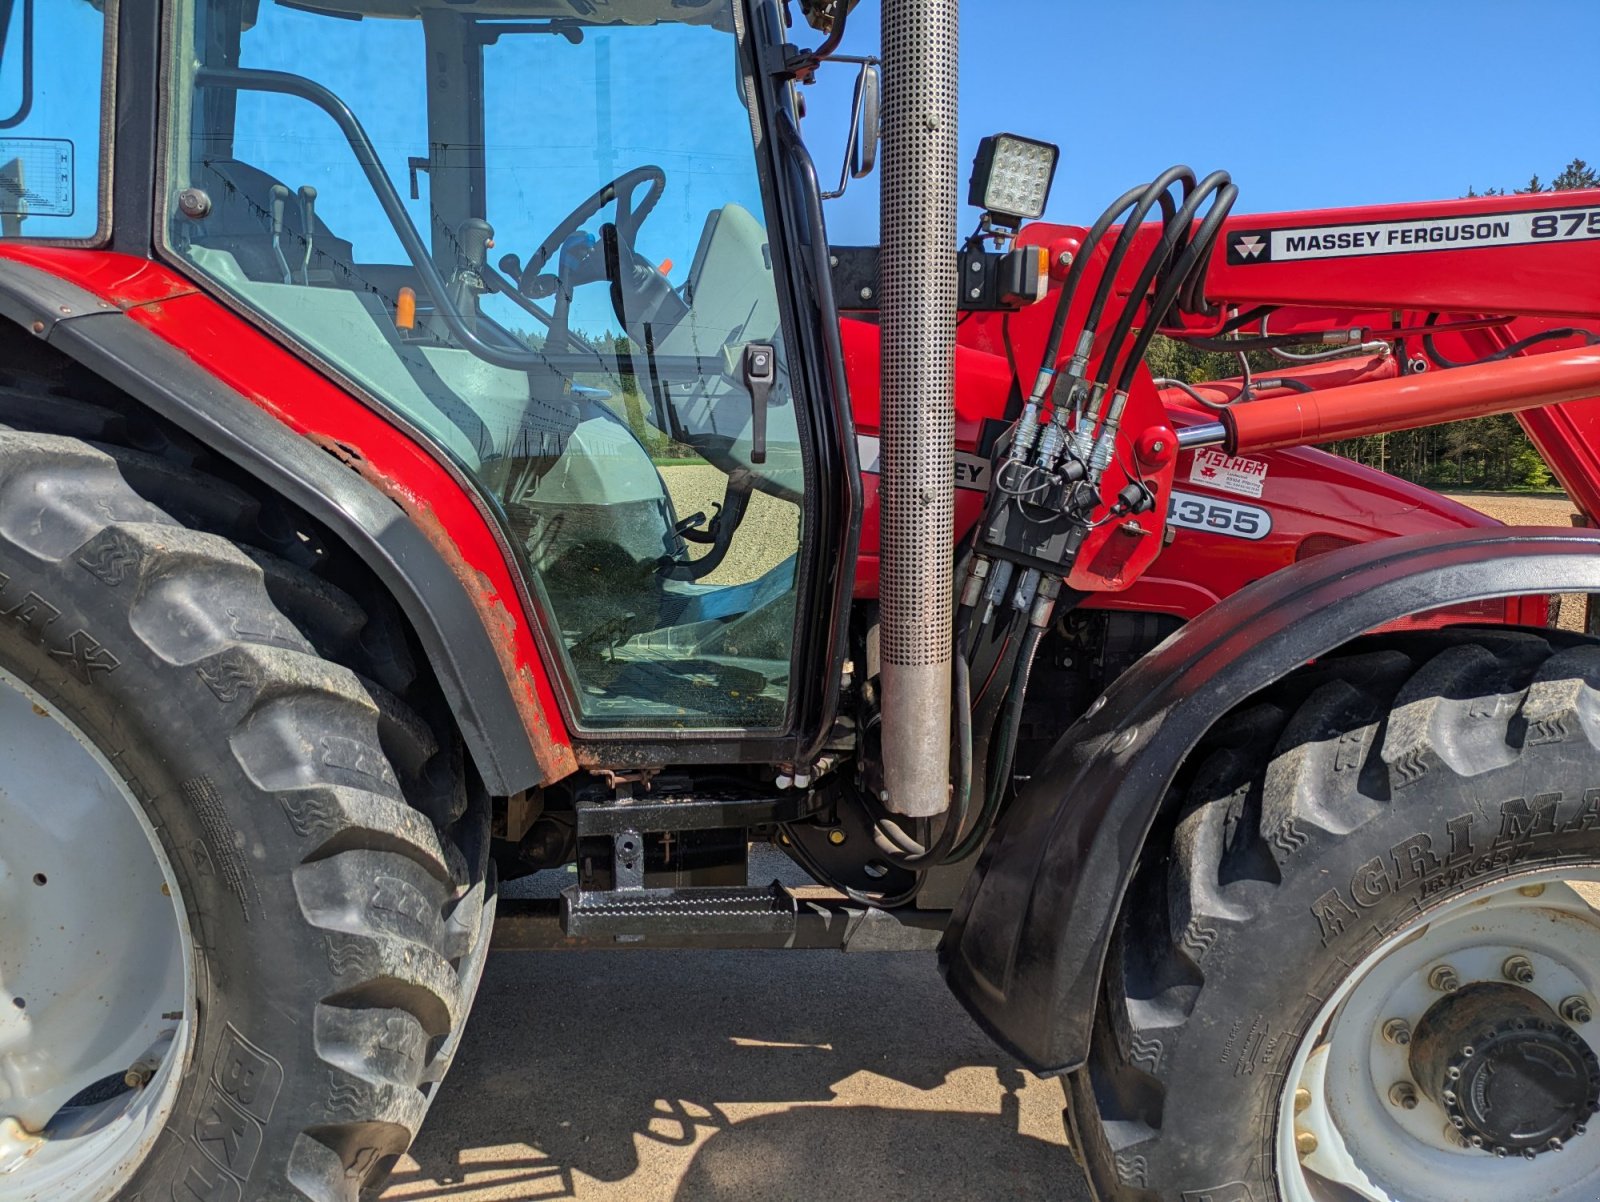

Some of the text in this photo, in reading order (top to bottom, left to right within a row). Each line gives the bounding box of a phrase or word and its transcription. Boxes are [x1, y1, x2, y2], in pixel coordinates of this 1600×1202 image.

[1286, 230, 1381, 252] MASSEY
[1387, 222, 1510, 246] FERGUSON
[0, 572, 121, 686] AX
